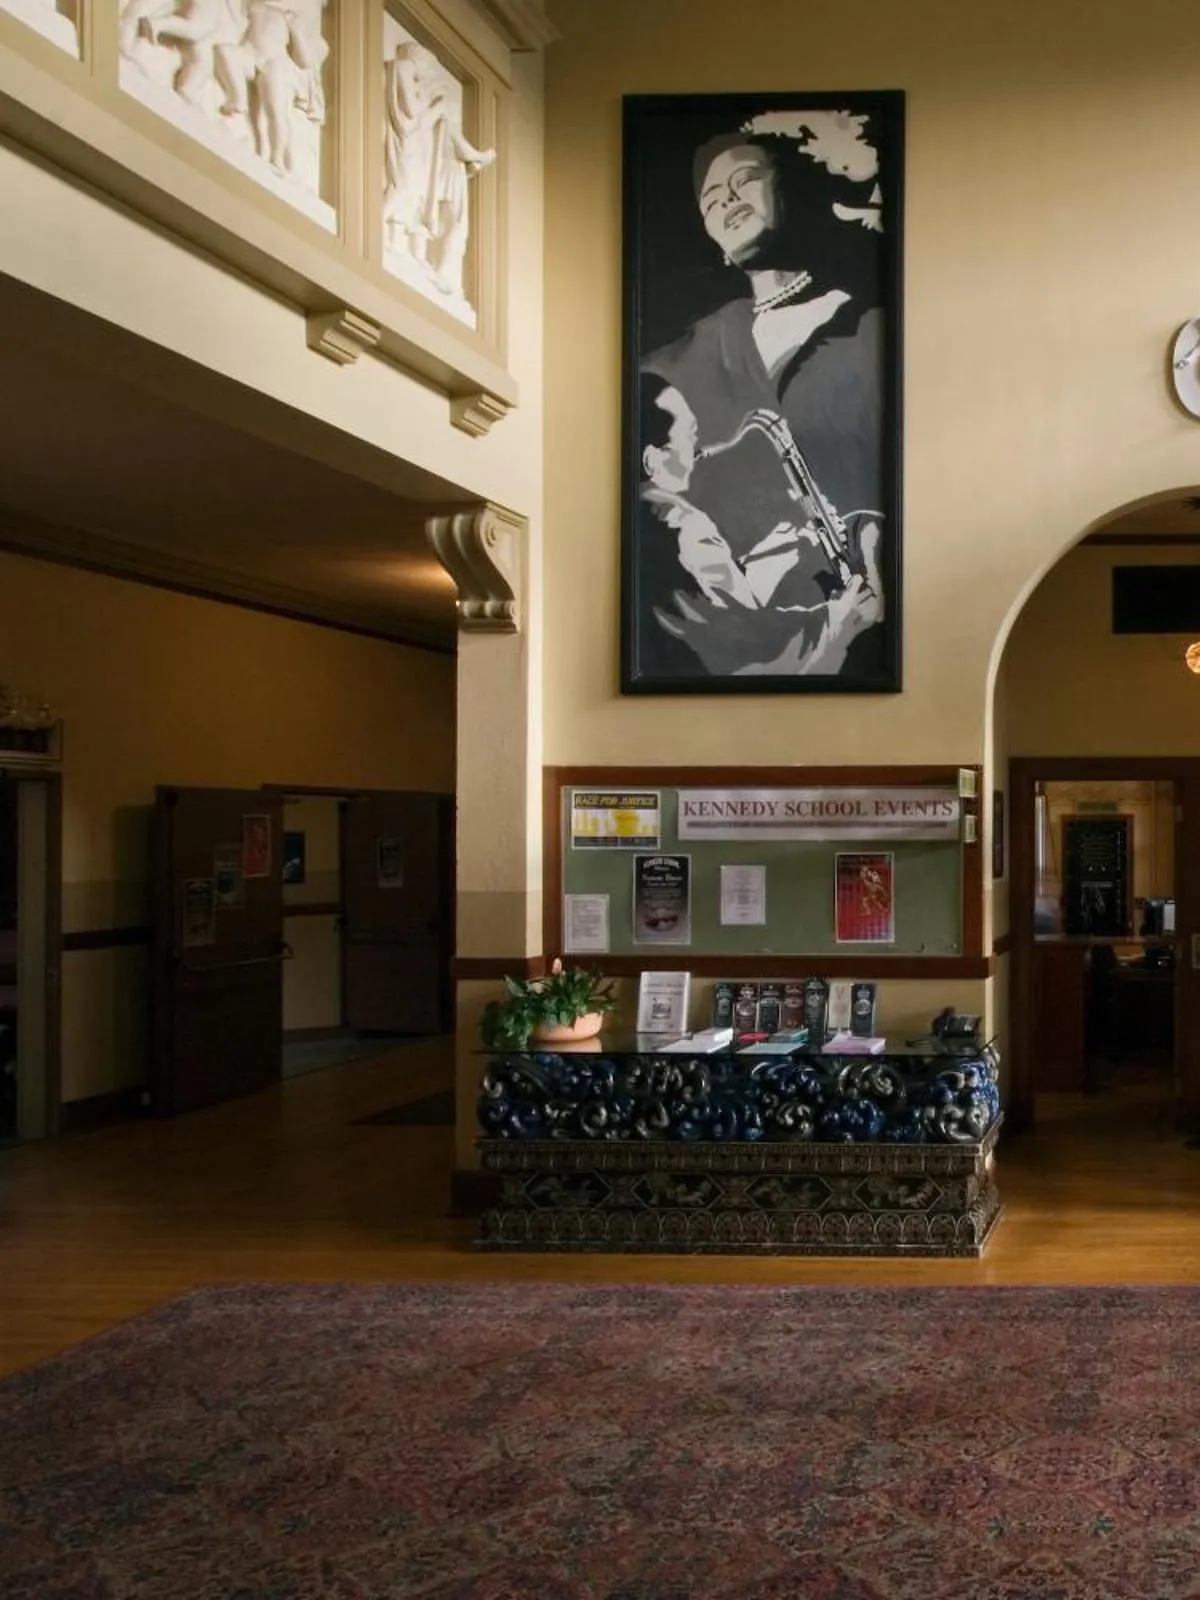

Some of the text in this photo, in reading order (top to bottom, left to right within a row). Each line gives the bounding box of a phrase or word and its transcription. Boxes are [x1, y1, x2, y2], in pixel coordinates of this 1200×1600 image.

[683, 800, 953, 817] KENNEDY SCHOOL EVENTS
